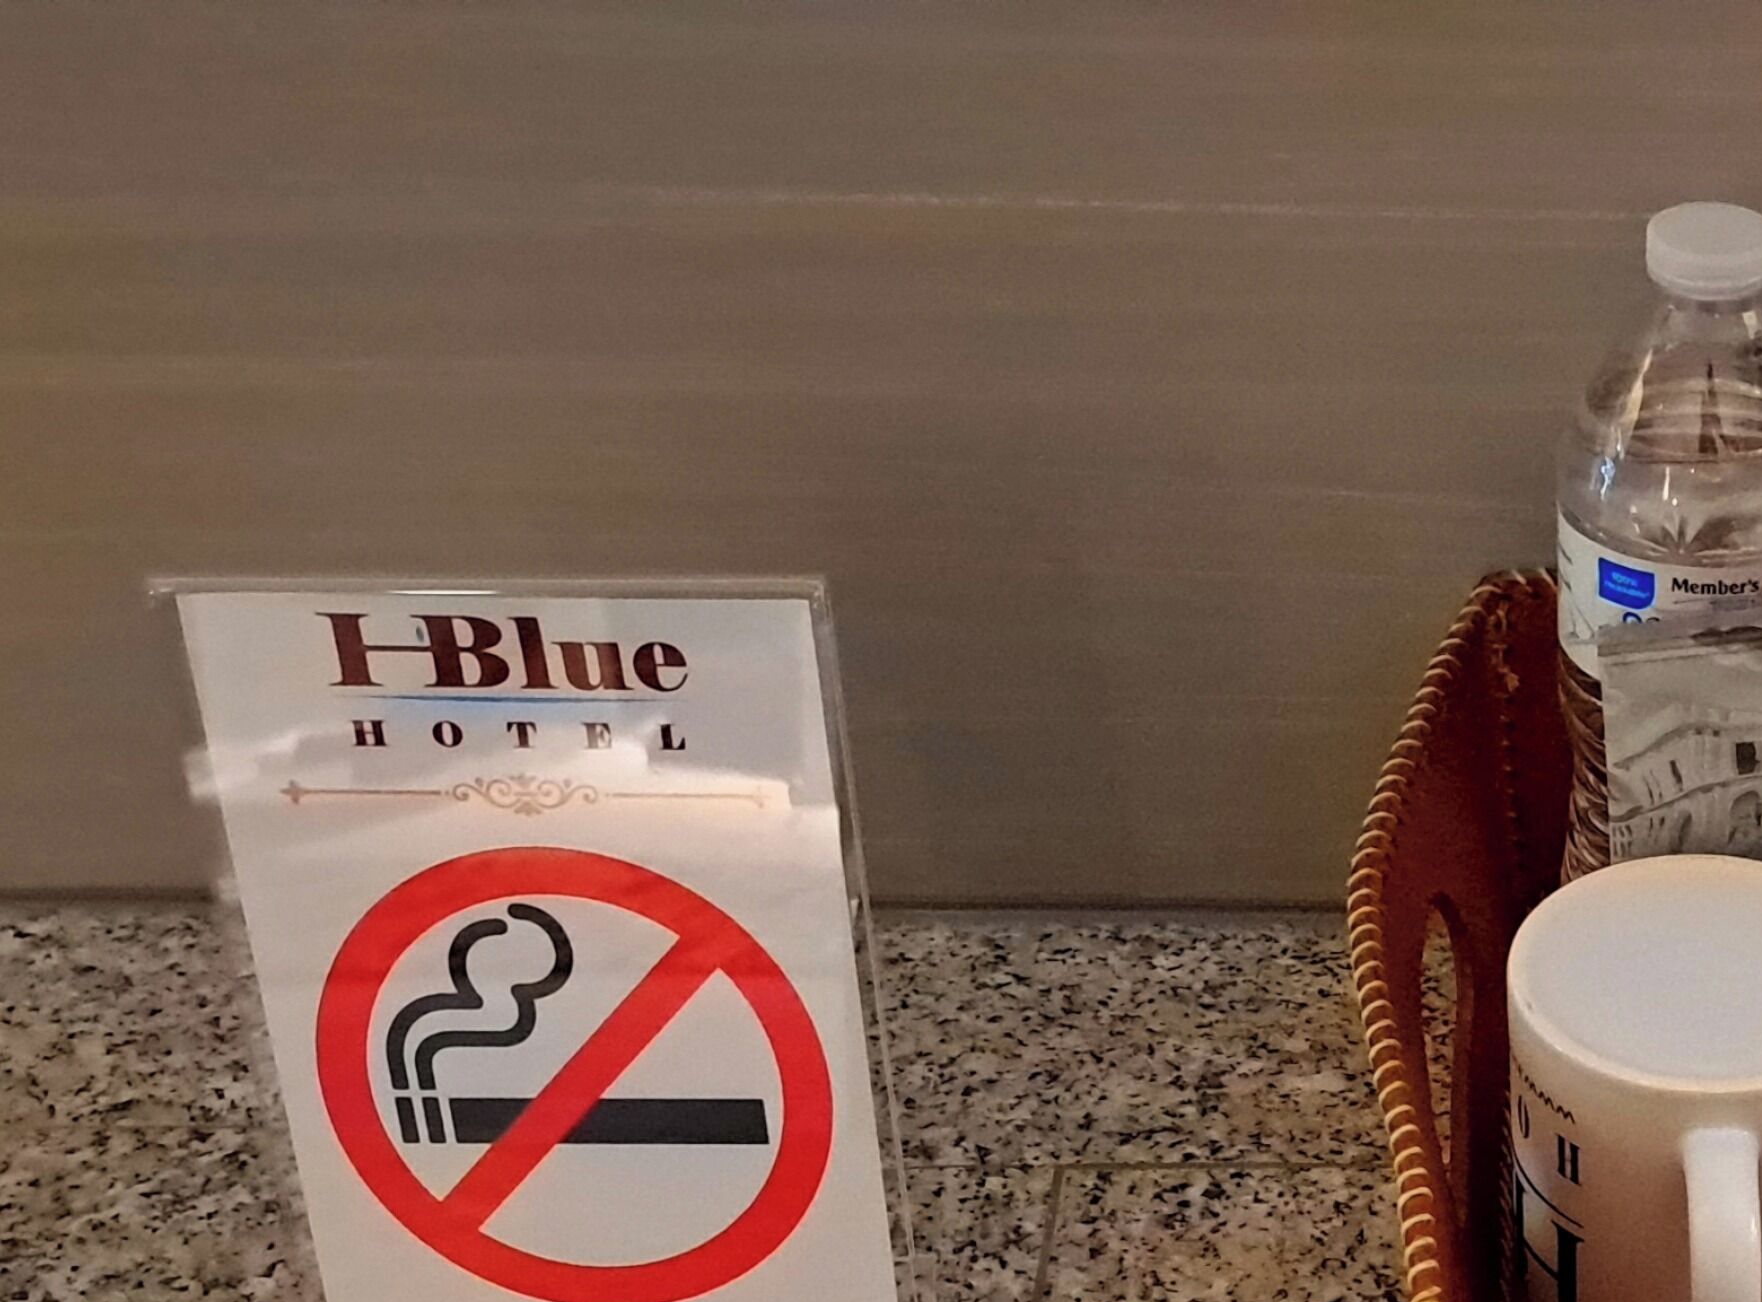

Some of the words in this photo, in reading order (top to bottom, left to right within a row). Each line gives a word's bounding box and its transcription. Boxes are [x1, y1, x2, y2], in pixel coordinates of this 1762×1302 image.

[1671, 577, 1760, 596] Member's
[315, 611, 689, 693] HBlue
[351, 719, 687, 752] HOTEL
